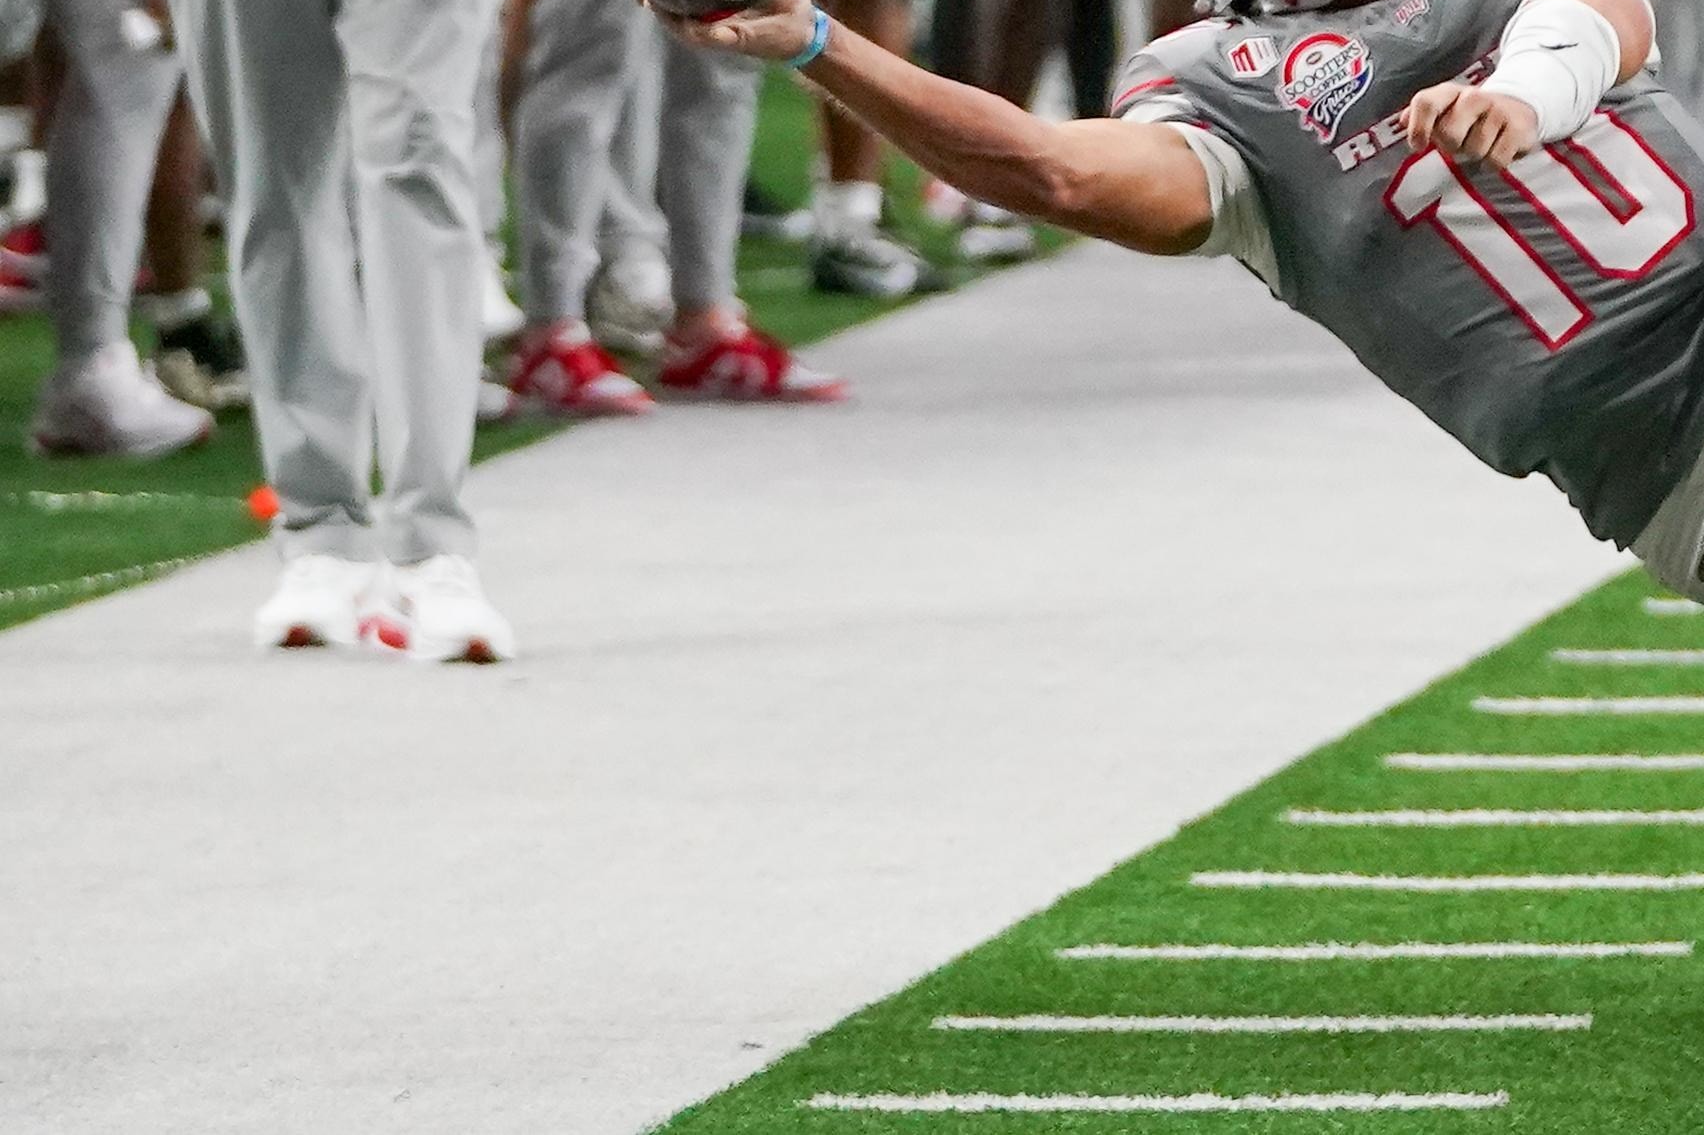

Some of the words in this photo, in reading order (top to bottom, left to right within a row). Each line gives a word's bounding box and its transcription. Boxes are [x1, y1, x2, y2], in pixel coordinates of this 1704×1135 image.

[1285, 43, 1361, 100] SCOOTER'S
[1310, 67, 1348, 98] COFFEE
[1382, 109, 1695, 351] 10
